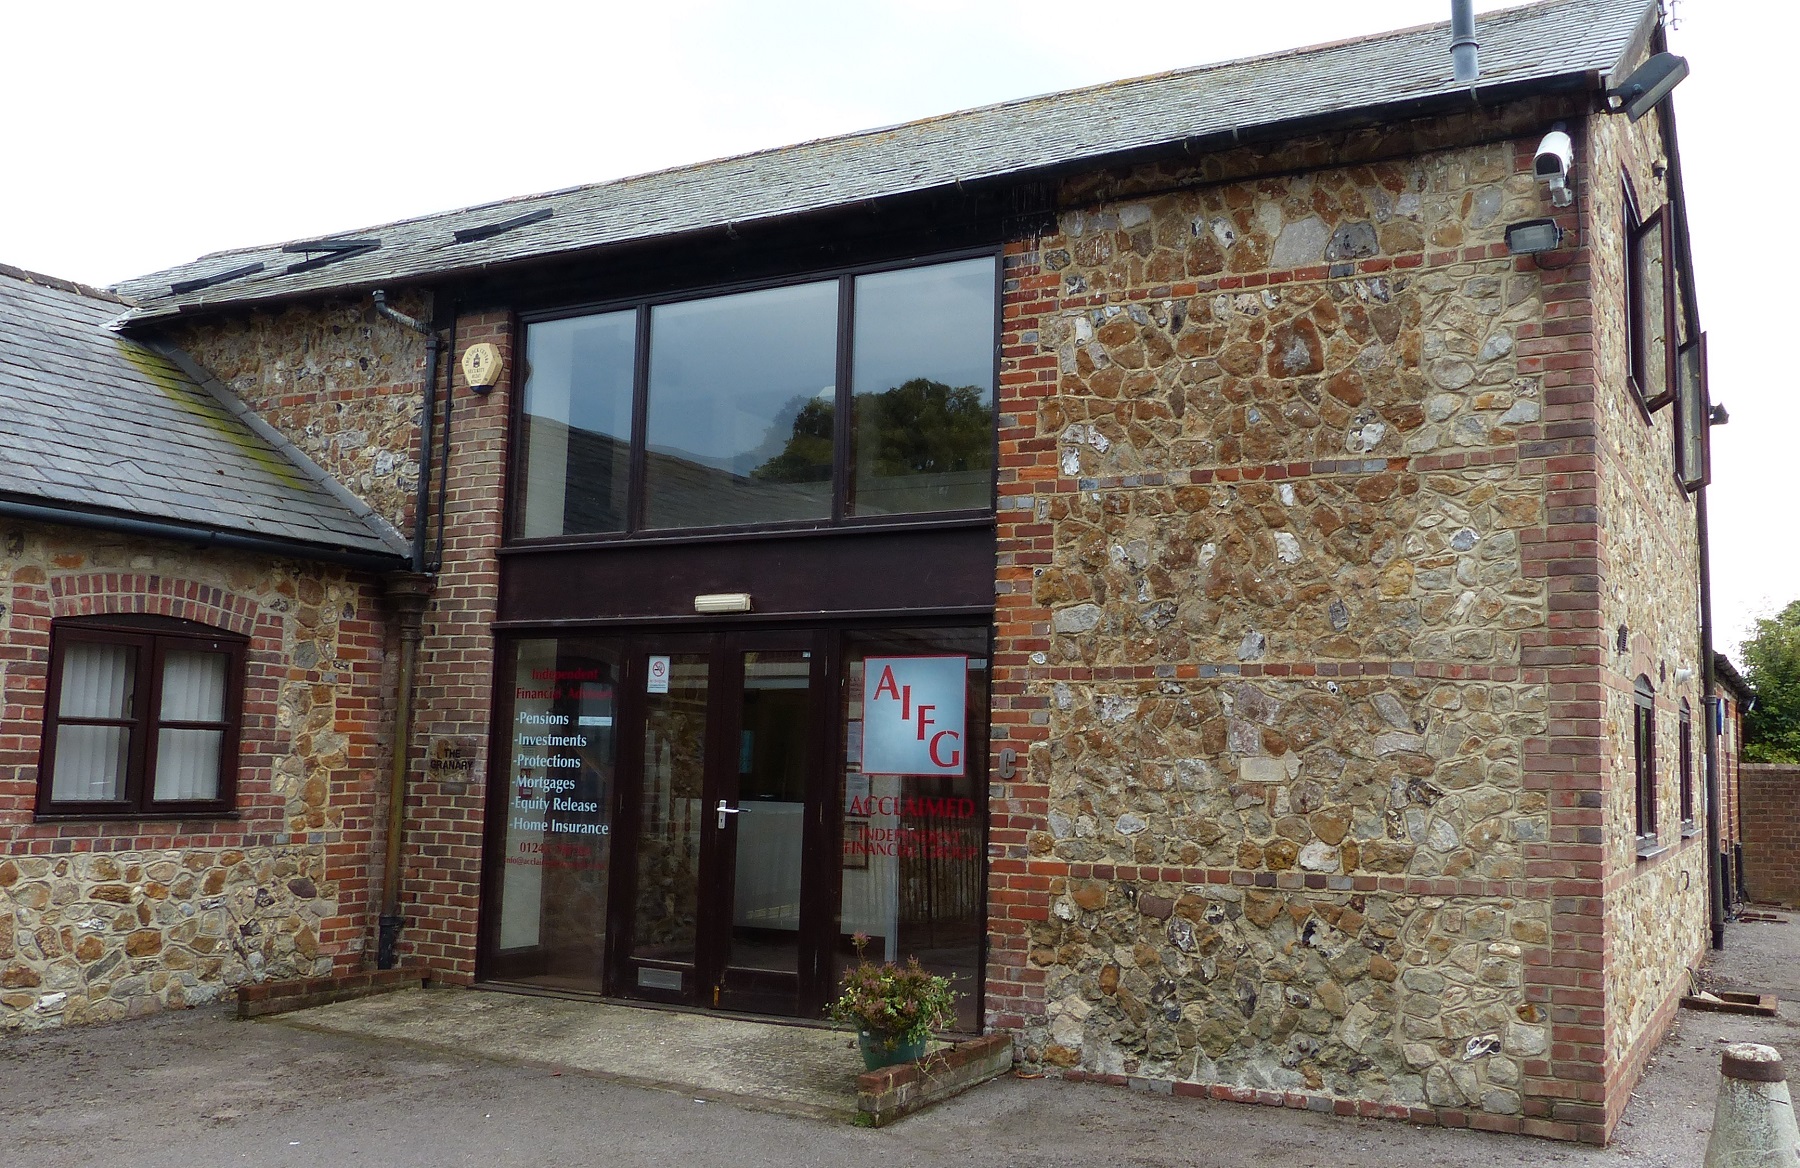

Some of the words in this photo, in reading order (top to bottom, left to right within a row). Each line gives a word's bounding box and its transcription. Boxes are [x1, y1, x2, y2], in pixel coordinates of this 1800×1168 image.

[531, 667, 600, 682] Independent
[516, 686, 562, 700] Financial
[444, 749, 462, 758] THE
[430, 760, 474, 770] GRANARY
[553, 798, 598, 813] Release
[849, 795, 976, 818] ACCLAIMED
[551, 819, 609, 835] Insurance
[858, 827, 961, 843] INDEPENDENT
[844, 841, 916, 858] FINANCIAL
[923, 845, 978, 860] GROUP
